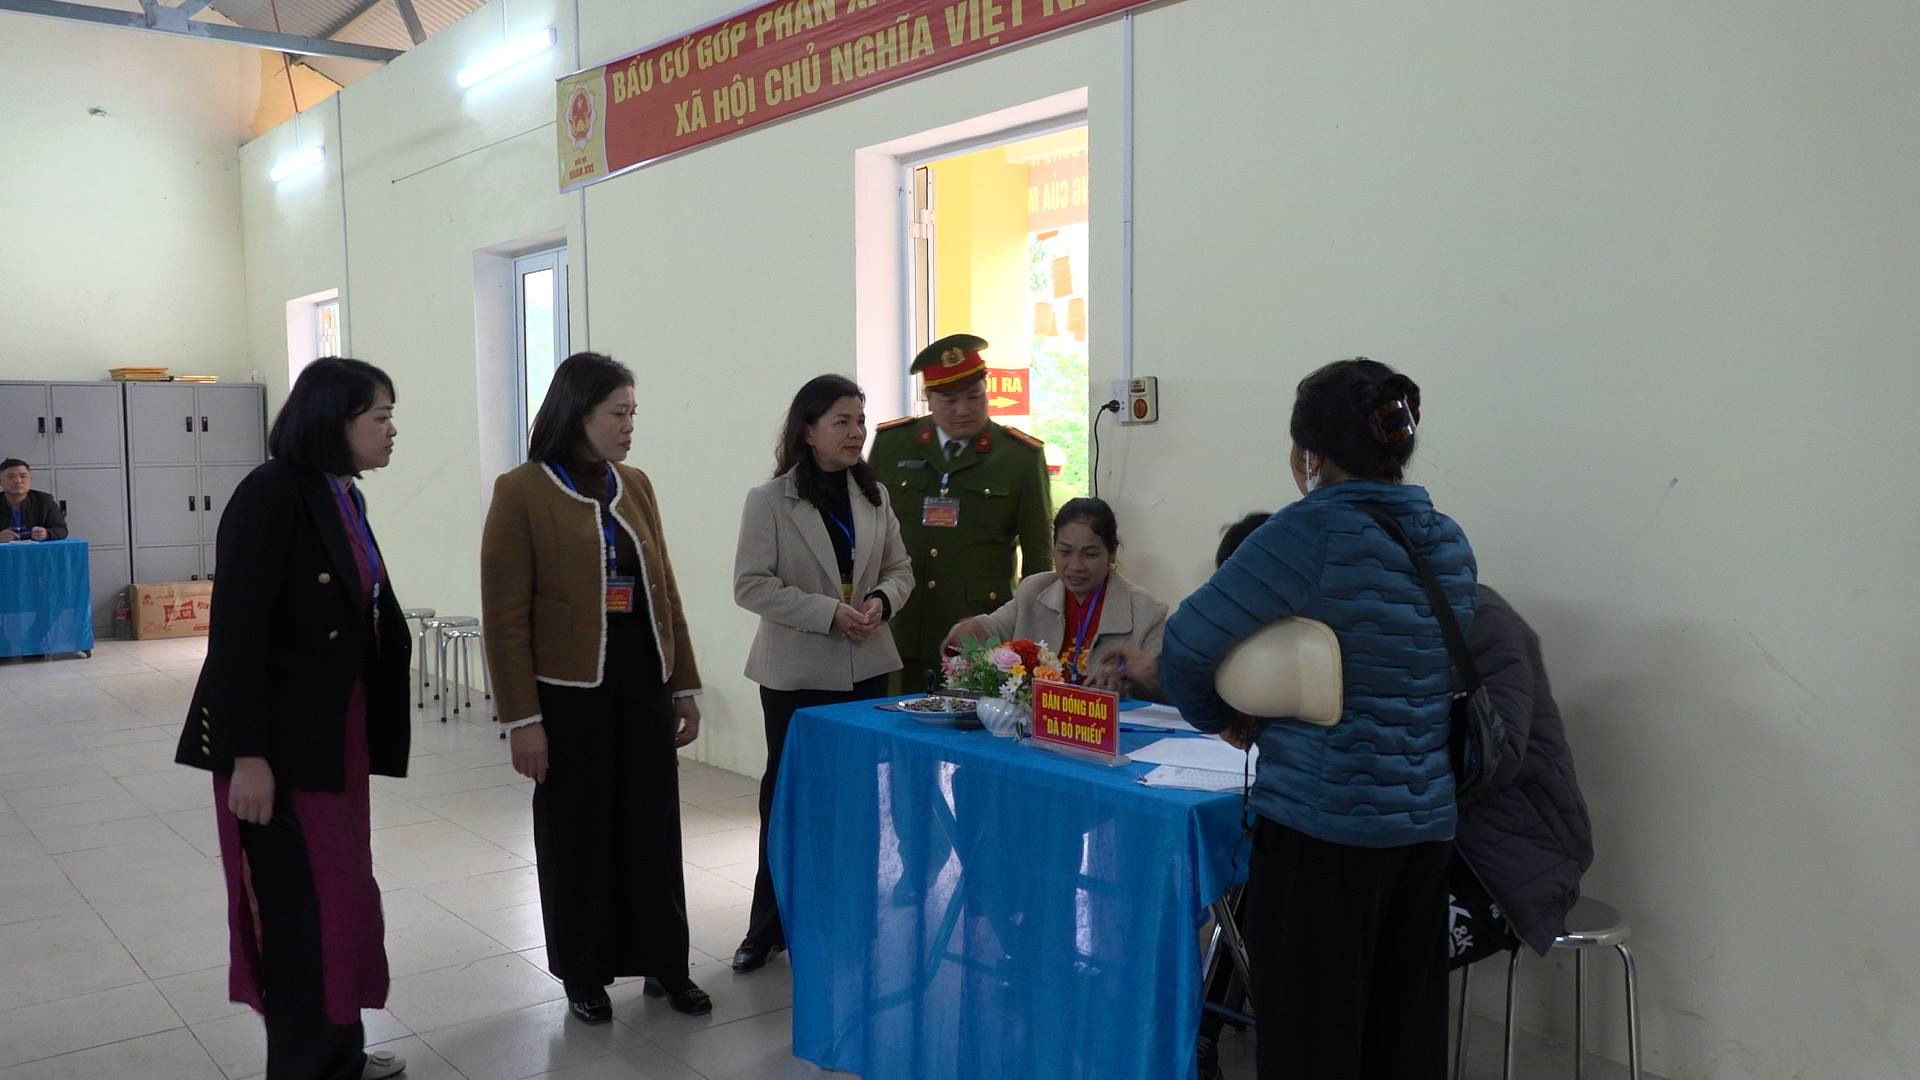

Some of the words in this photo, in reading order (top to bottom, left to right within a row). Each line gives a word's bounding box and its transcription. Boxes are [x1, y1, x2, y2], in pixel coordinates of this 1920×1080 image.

[660, 35, 695, 84] CỬ
[697, 21, 748, 71] GÓP
[673, 87, 708, 137] XÃ
[712, 73, 757, 125] HỘI
[764, 42, 822, 106] CHỦ
[830, 12, 935, 86] NGHĨA
[1001, 376, 1023, 393] RA
[1042, 690, 1061, 711] BÀN
[1062, 694, 1087, 717] ĐÓNG
[1088, 697, 1107, 721] DẤU
[1061, 716, 1074, 739] BỎ
